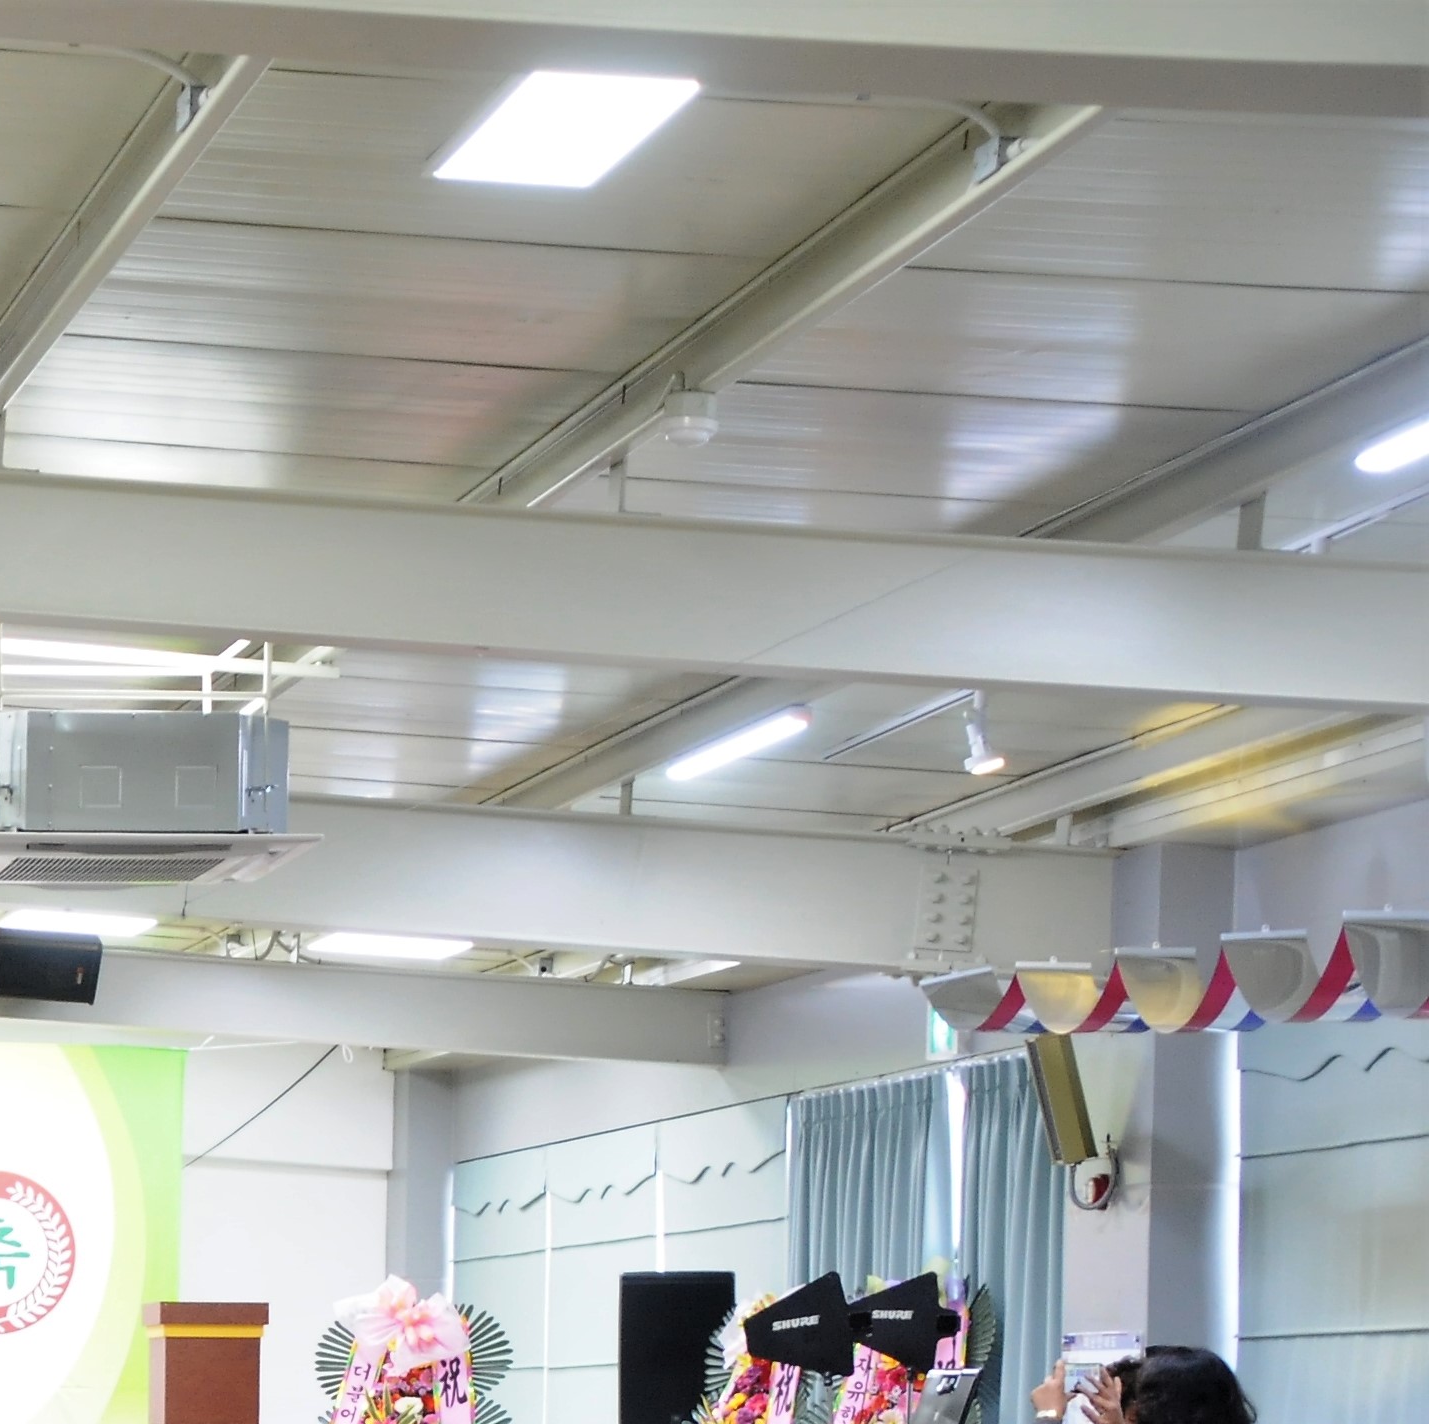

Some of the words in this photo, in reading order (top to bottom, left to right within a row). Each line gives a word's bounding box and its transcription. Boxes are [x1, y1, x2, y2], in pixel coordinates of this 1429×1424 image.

[772, 1314, 821, 1332] SHURE
[871, 1309, 915, 1320] SHURE
[438, 1355, 469, 1408] 祝
